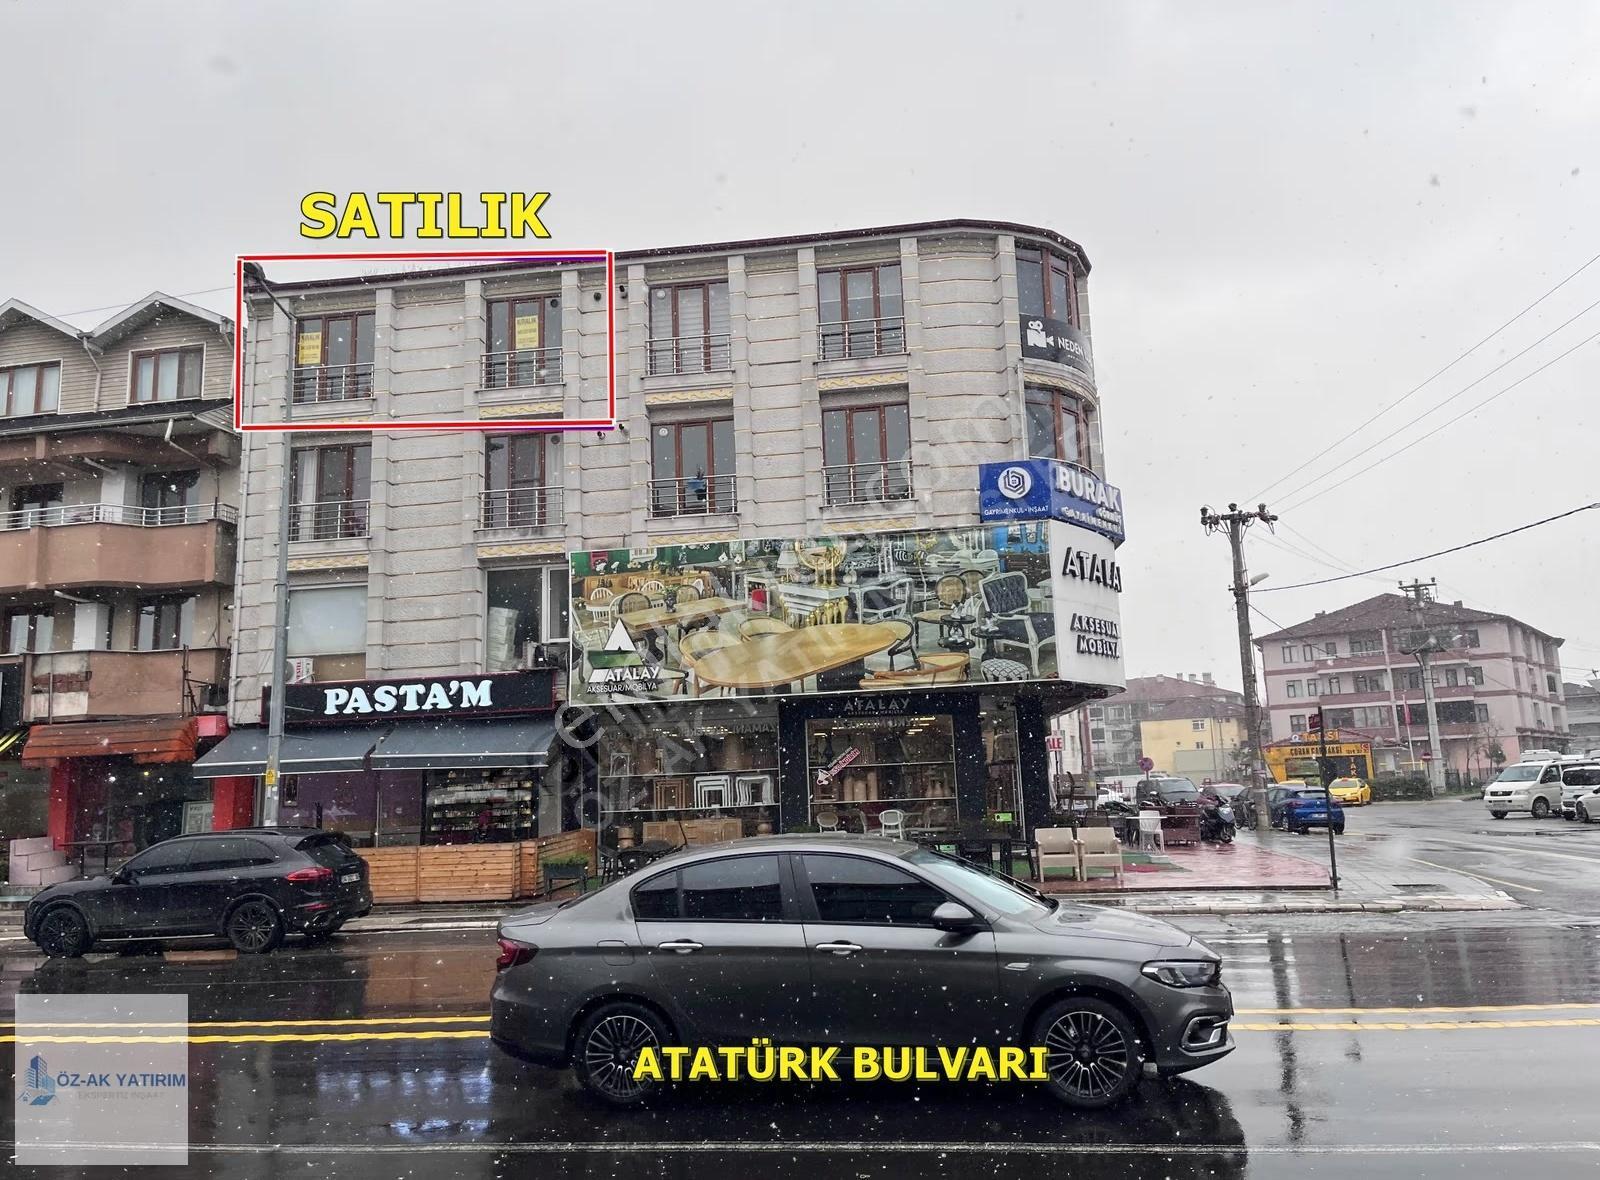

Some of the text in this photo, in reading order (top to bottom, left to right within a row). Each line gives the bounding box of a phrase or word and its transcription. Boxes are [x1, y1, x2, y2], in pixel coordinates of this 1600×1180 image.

[1055, 466, 1120, 511] BURAK
[605, 666, 659, 682] ATALAY
[324, 680, 493, 715] PASTA'M
[844, 698, 910, 711] ATALAY
